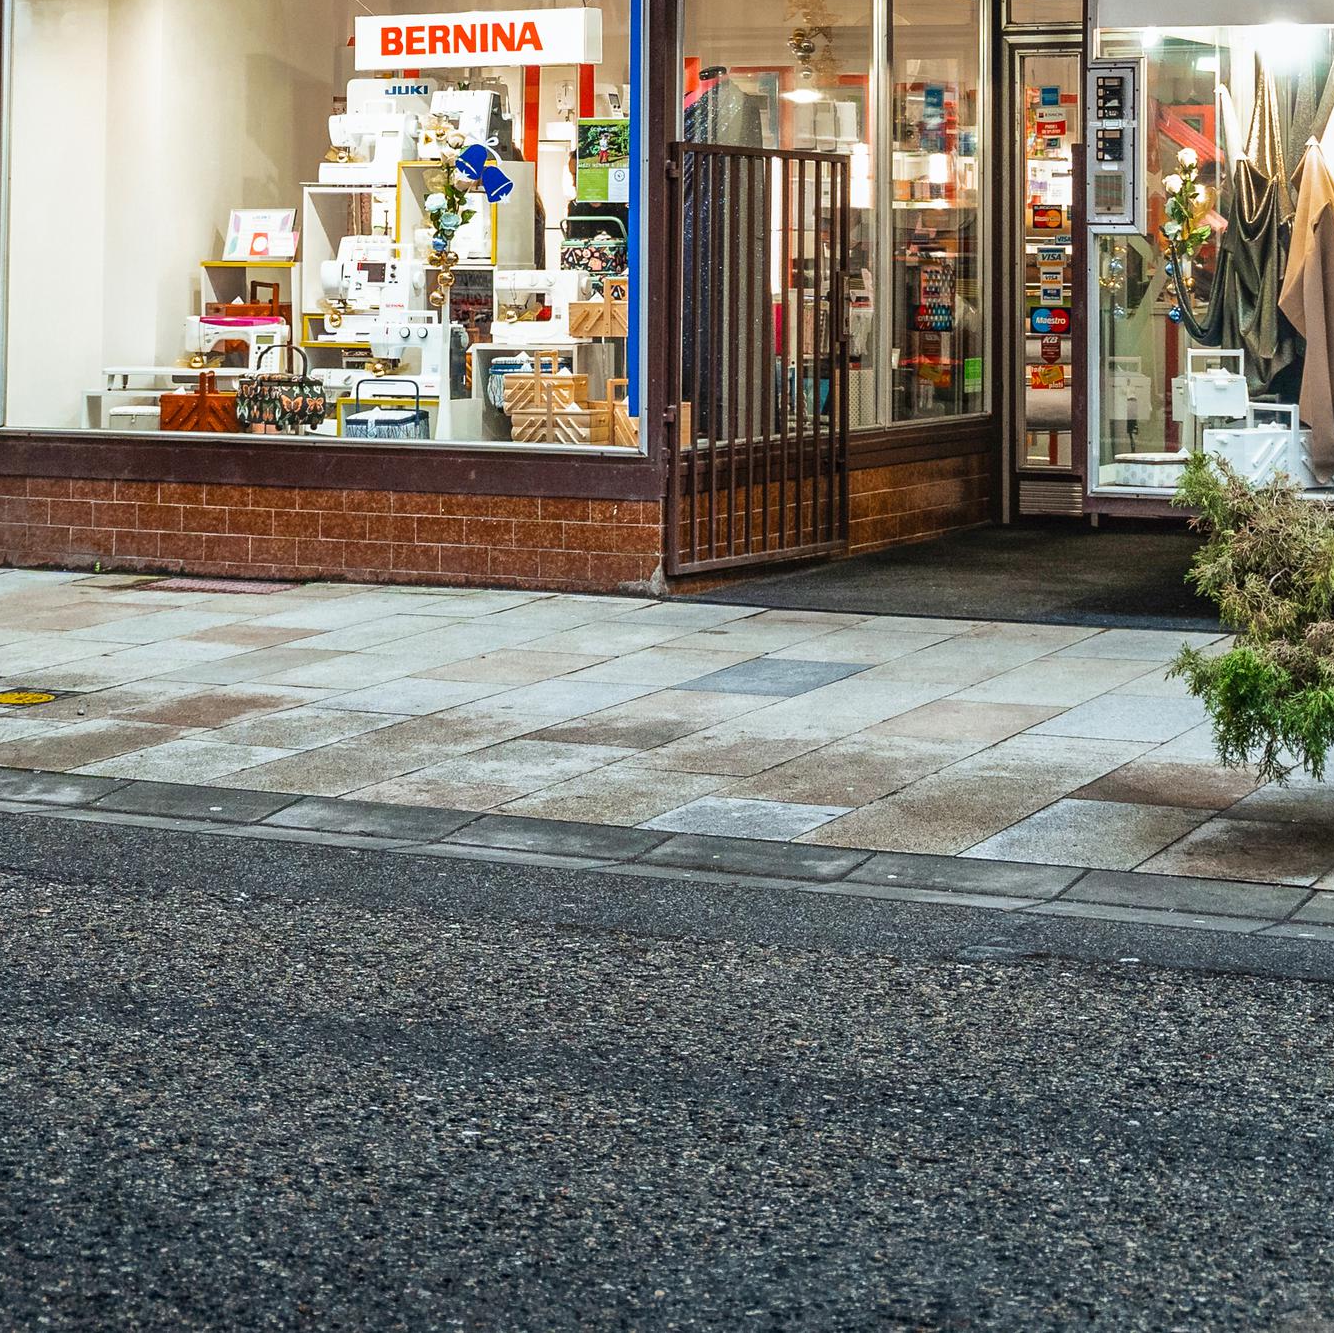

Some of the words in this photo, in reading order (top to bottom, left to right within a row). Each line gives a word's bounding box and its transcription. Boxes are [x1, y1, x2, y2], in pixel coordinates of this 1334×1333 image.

[380, 21, 544, 56] BERNINA
[384, 84, 429, 95] JUKI
[1035, 316, 1067, 325] Maestro
[1042, 336, 1059, 344] KB
